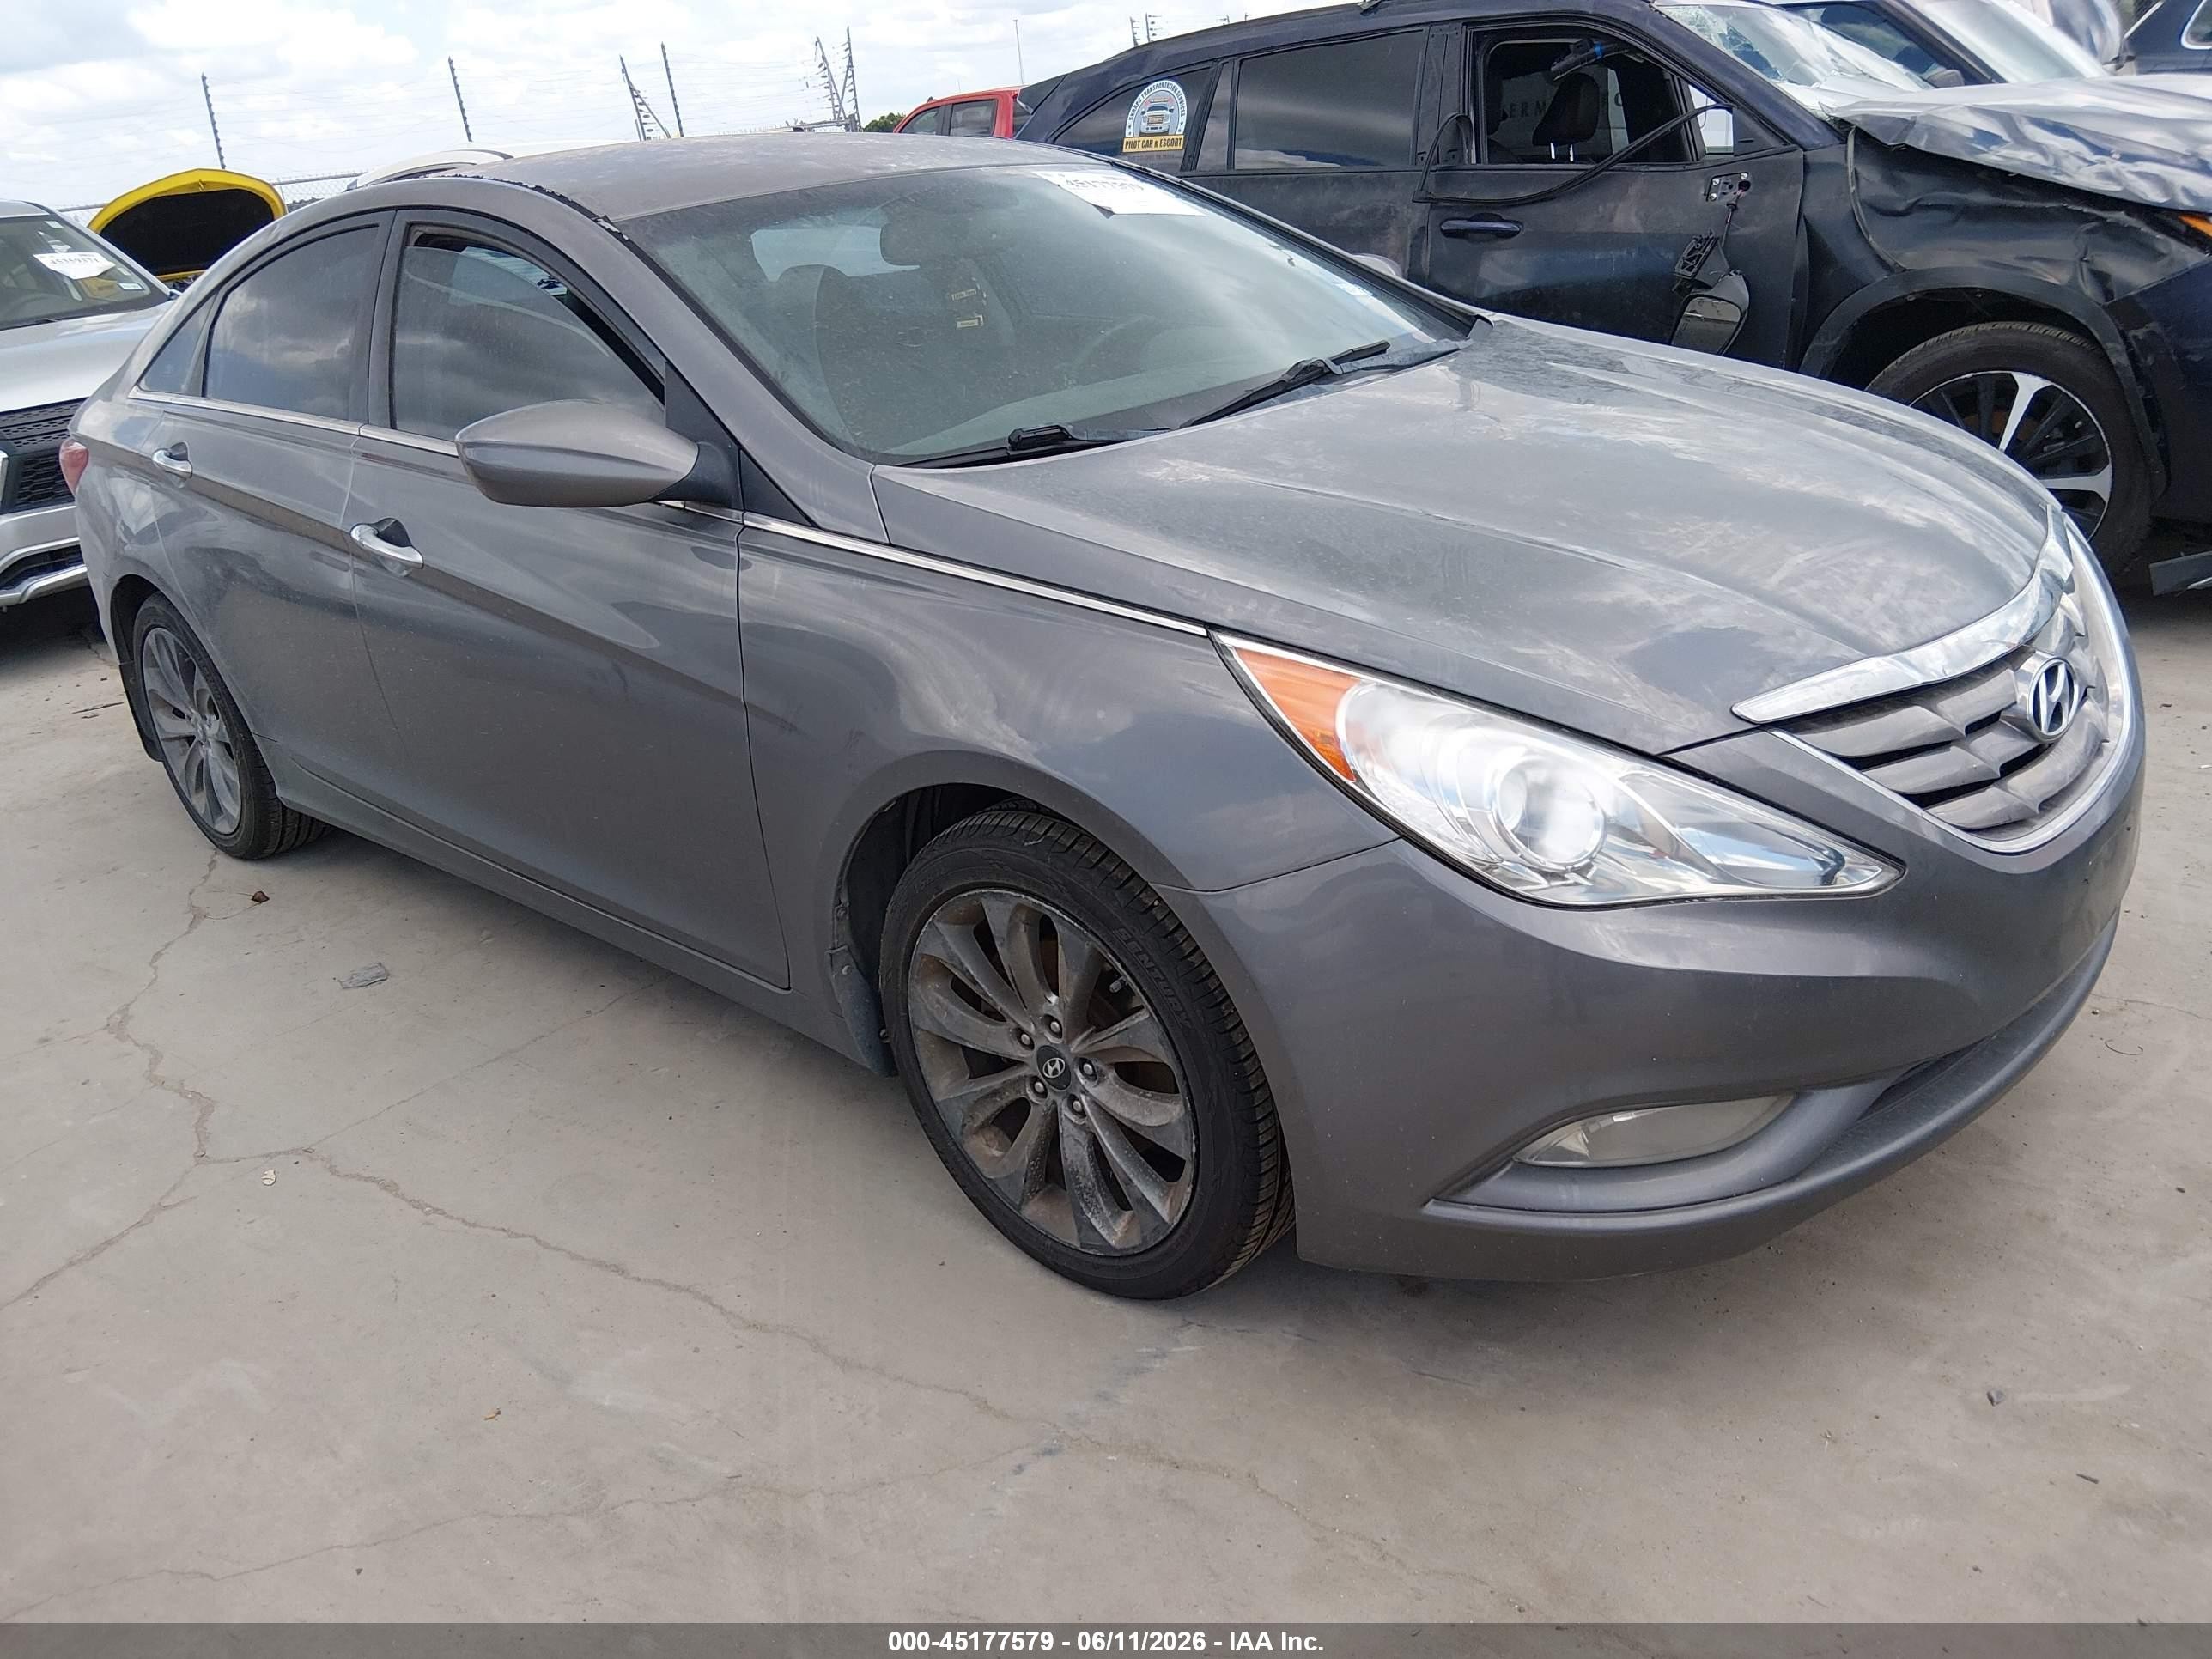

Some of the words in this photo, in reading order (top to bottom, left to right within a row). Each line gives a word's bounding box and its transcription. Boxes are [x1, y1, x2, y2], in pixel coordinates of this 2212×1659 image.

[1125, 140, 1141, 149] PILOT
[1141, 139, 1154, 149] CAR
[1159, 137, 1182, 148] ESCORT
